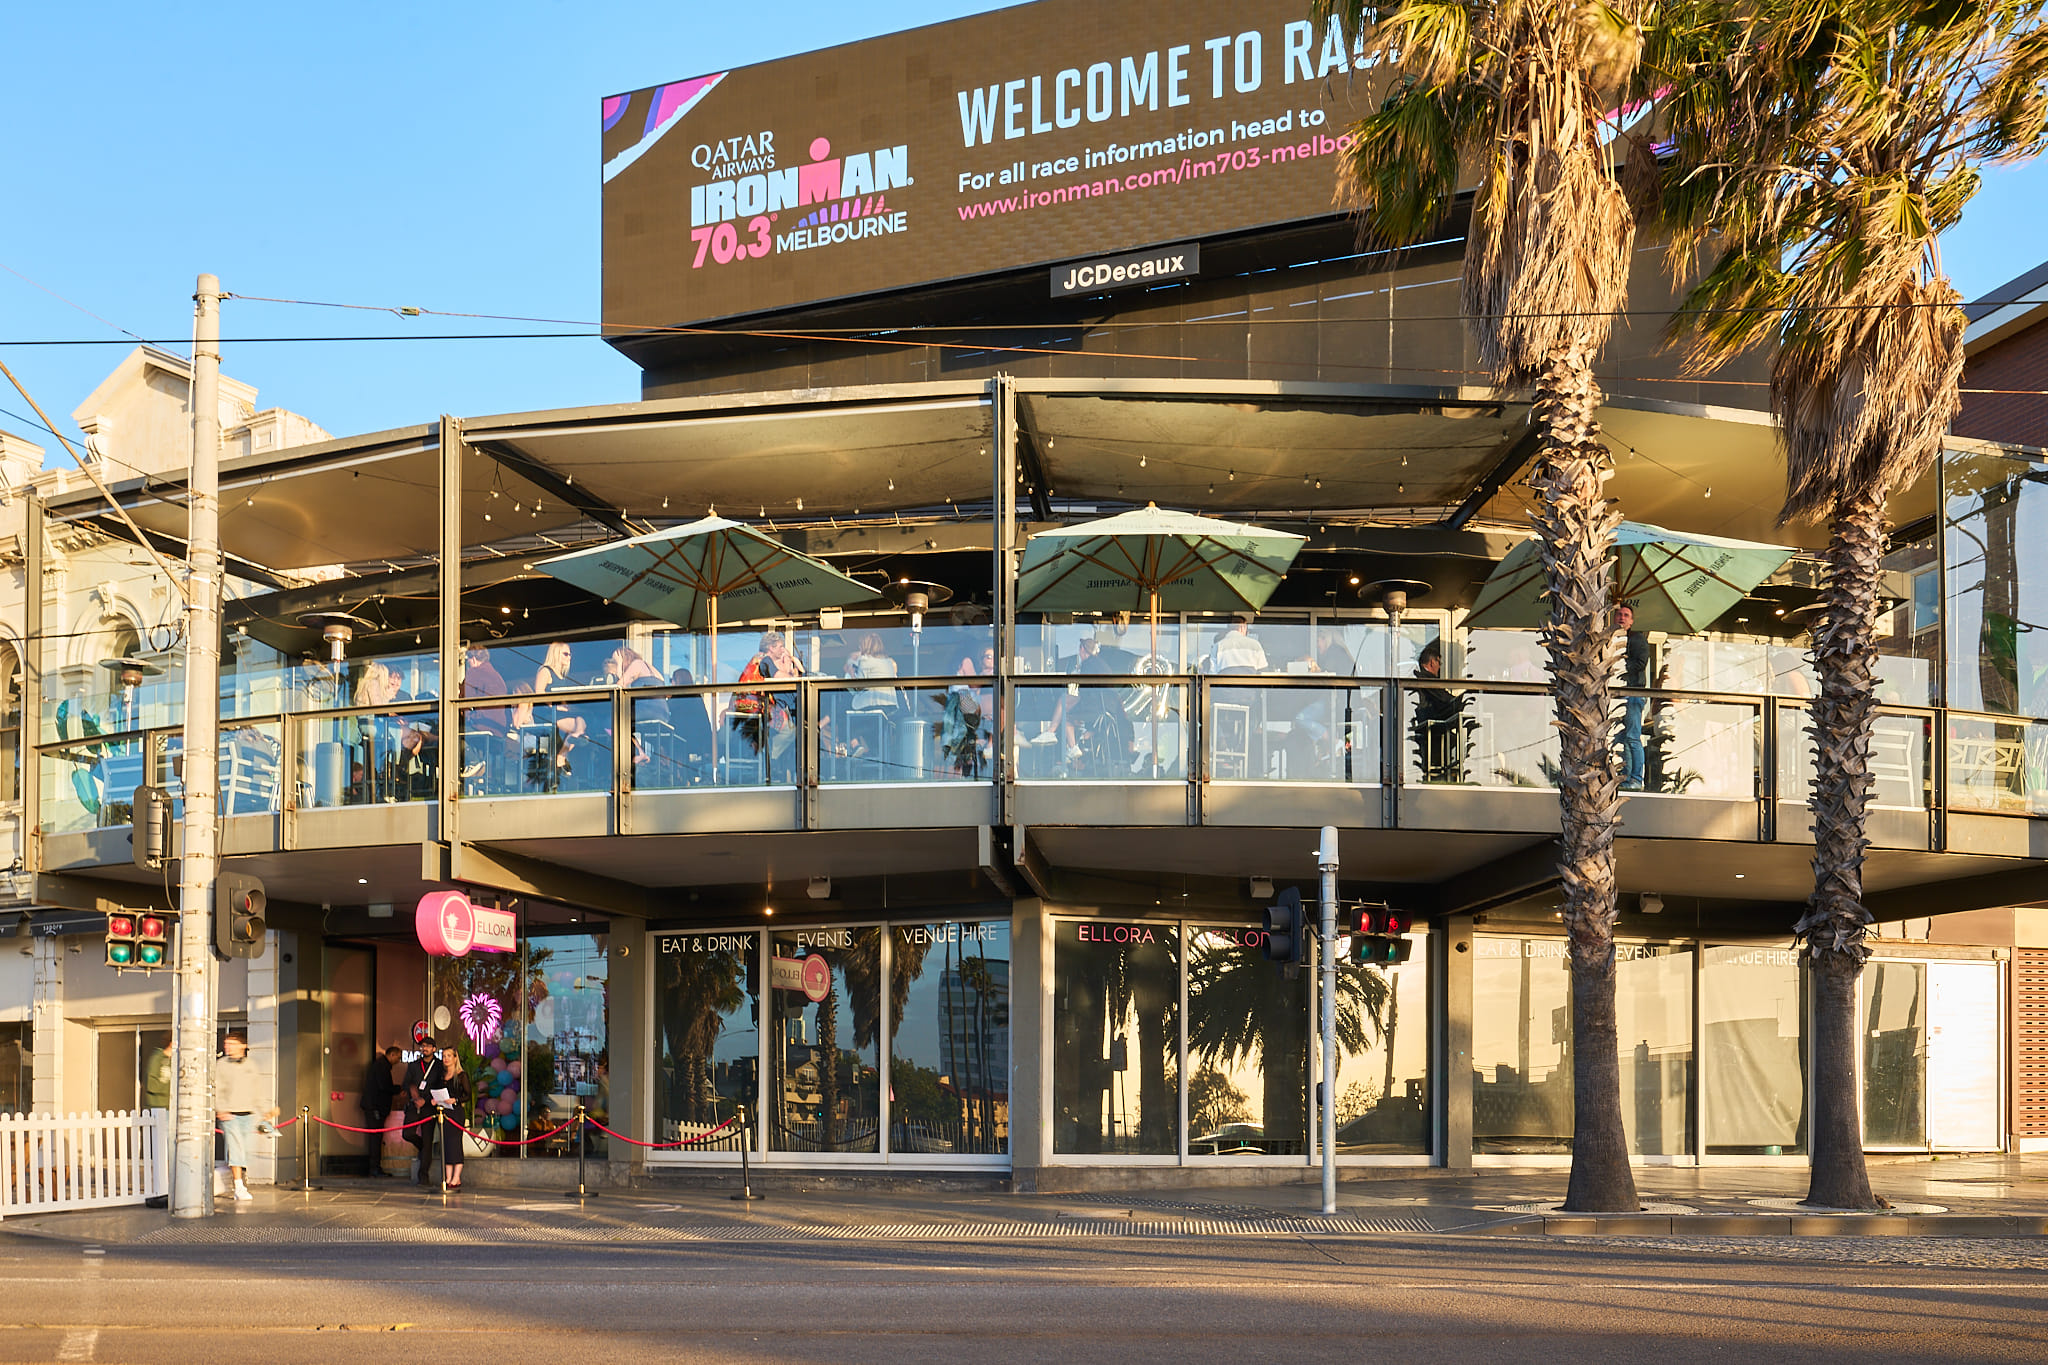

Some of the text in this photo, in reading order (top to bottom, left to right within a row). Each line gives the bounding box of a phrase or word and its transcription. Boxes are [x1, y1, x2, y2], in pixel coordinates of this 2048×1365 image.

[957, 7, 1403, 148] WELCOME TO RAC
[691, 130, 775, 170] QATAR
[958, 107, 1326, 193] For all race information head to
[711, 153, 775, 180] AIRWAYS
[957, 134, 1358, 221] www.ironman.com/im703-melbo
[691, 138, 908, 227] IRONMAN
[691, 211, 908, 269] 70.3 MELBOURNE
[1063, 255, 1185, 290] JCDecaux
[477, 920, 513, 938] ELLORA
[797, 930, 853, 949] EVENTS
[902, 925, 997, 945] VENUE HIRE
[1078, 925, 1156, 945] ELLORA
[1212, 930, 1271, 947] ELLO
[662, 934, 753, 954] EAT & DRINK
[1525, 942, 1572, 959] DRINK
[1766, 950, 1797, 966] HIRE
